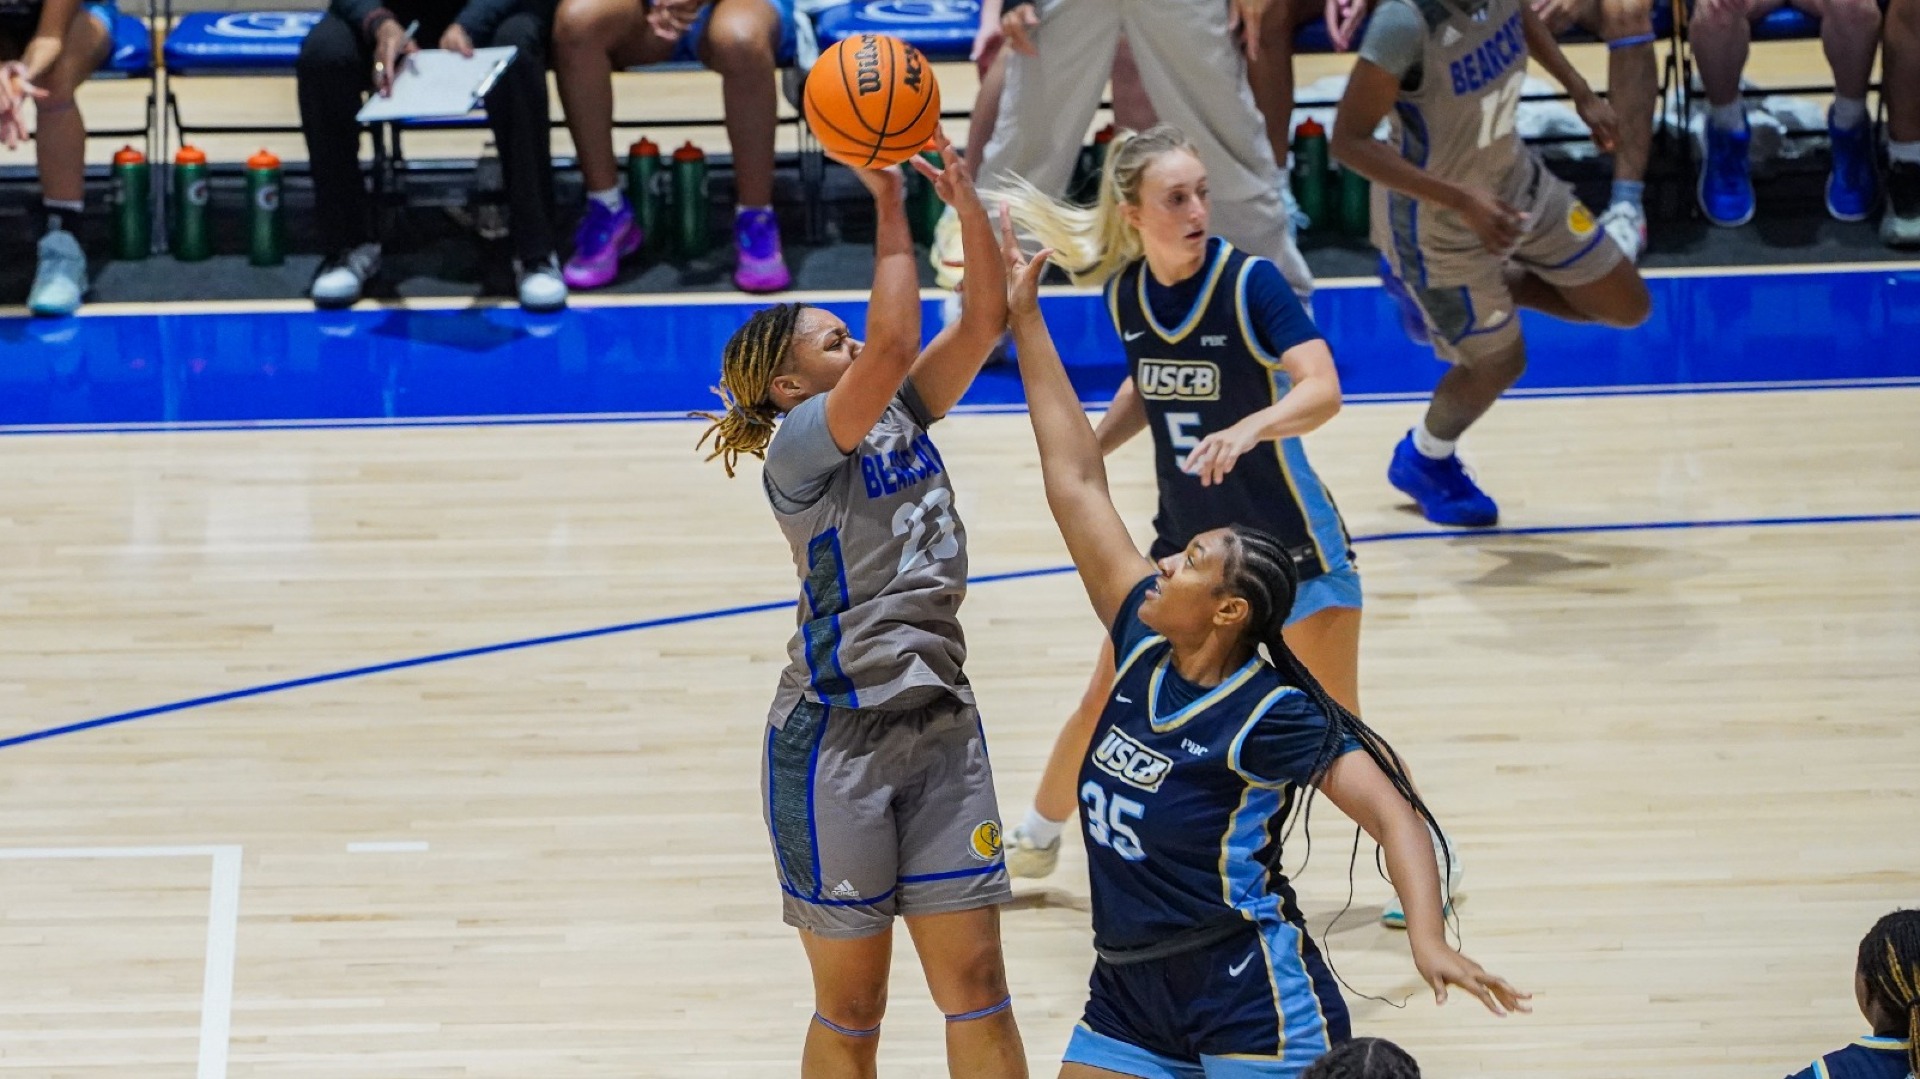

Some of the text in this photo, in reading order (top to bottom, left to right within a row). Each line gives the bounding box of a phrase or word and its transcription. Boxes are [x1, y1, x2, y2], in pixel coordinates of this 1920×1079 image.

[1140, 362, 1216, 397] USCB
[1163, 411, 1204, 476] 5
[891, 486, 959, 574] 23
[1094, 731, 1169, 785] USCB
[1080, 779, 1148, 862] 35
